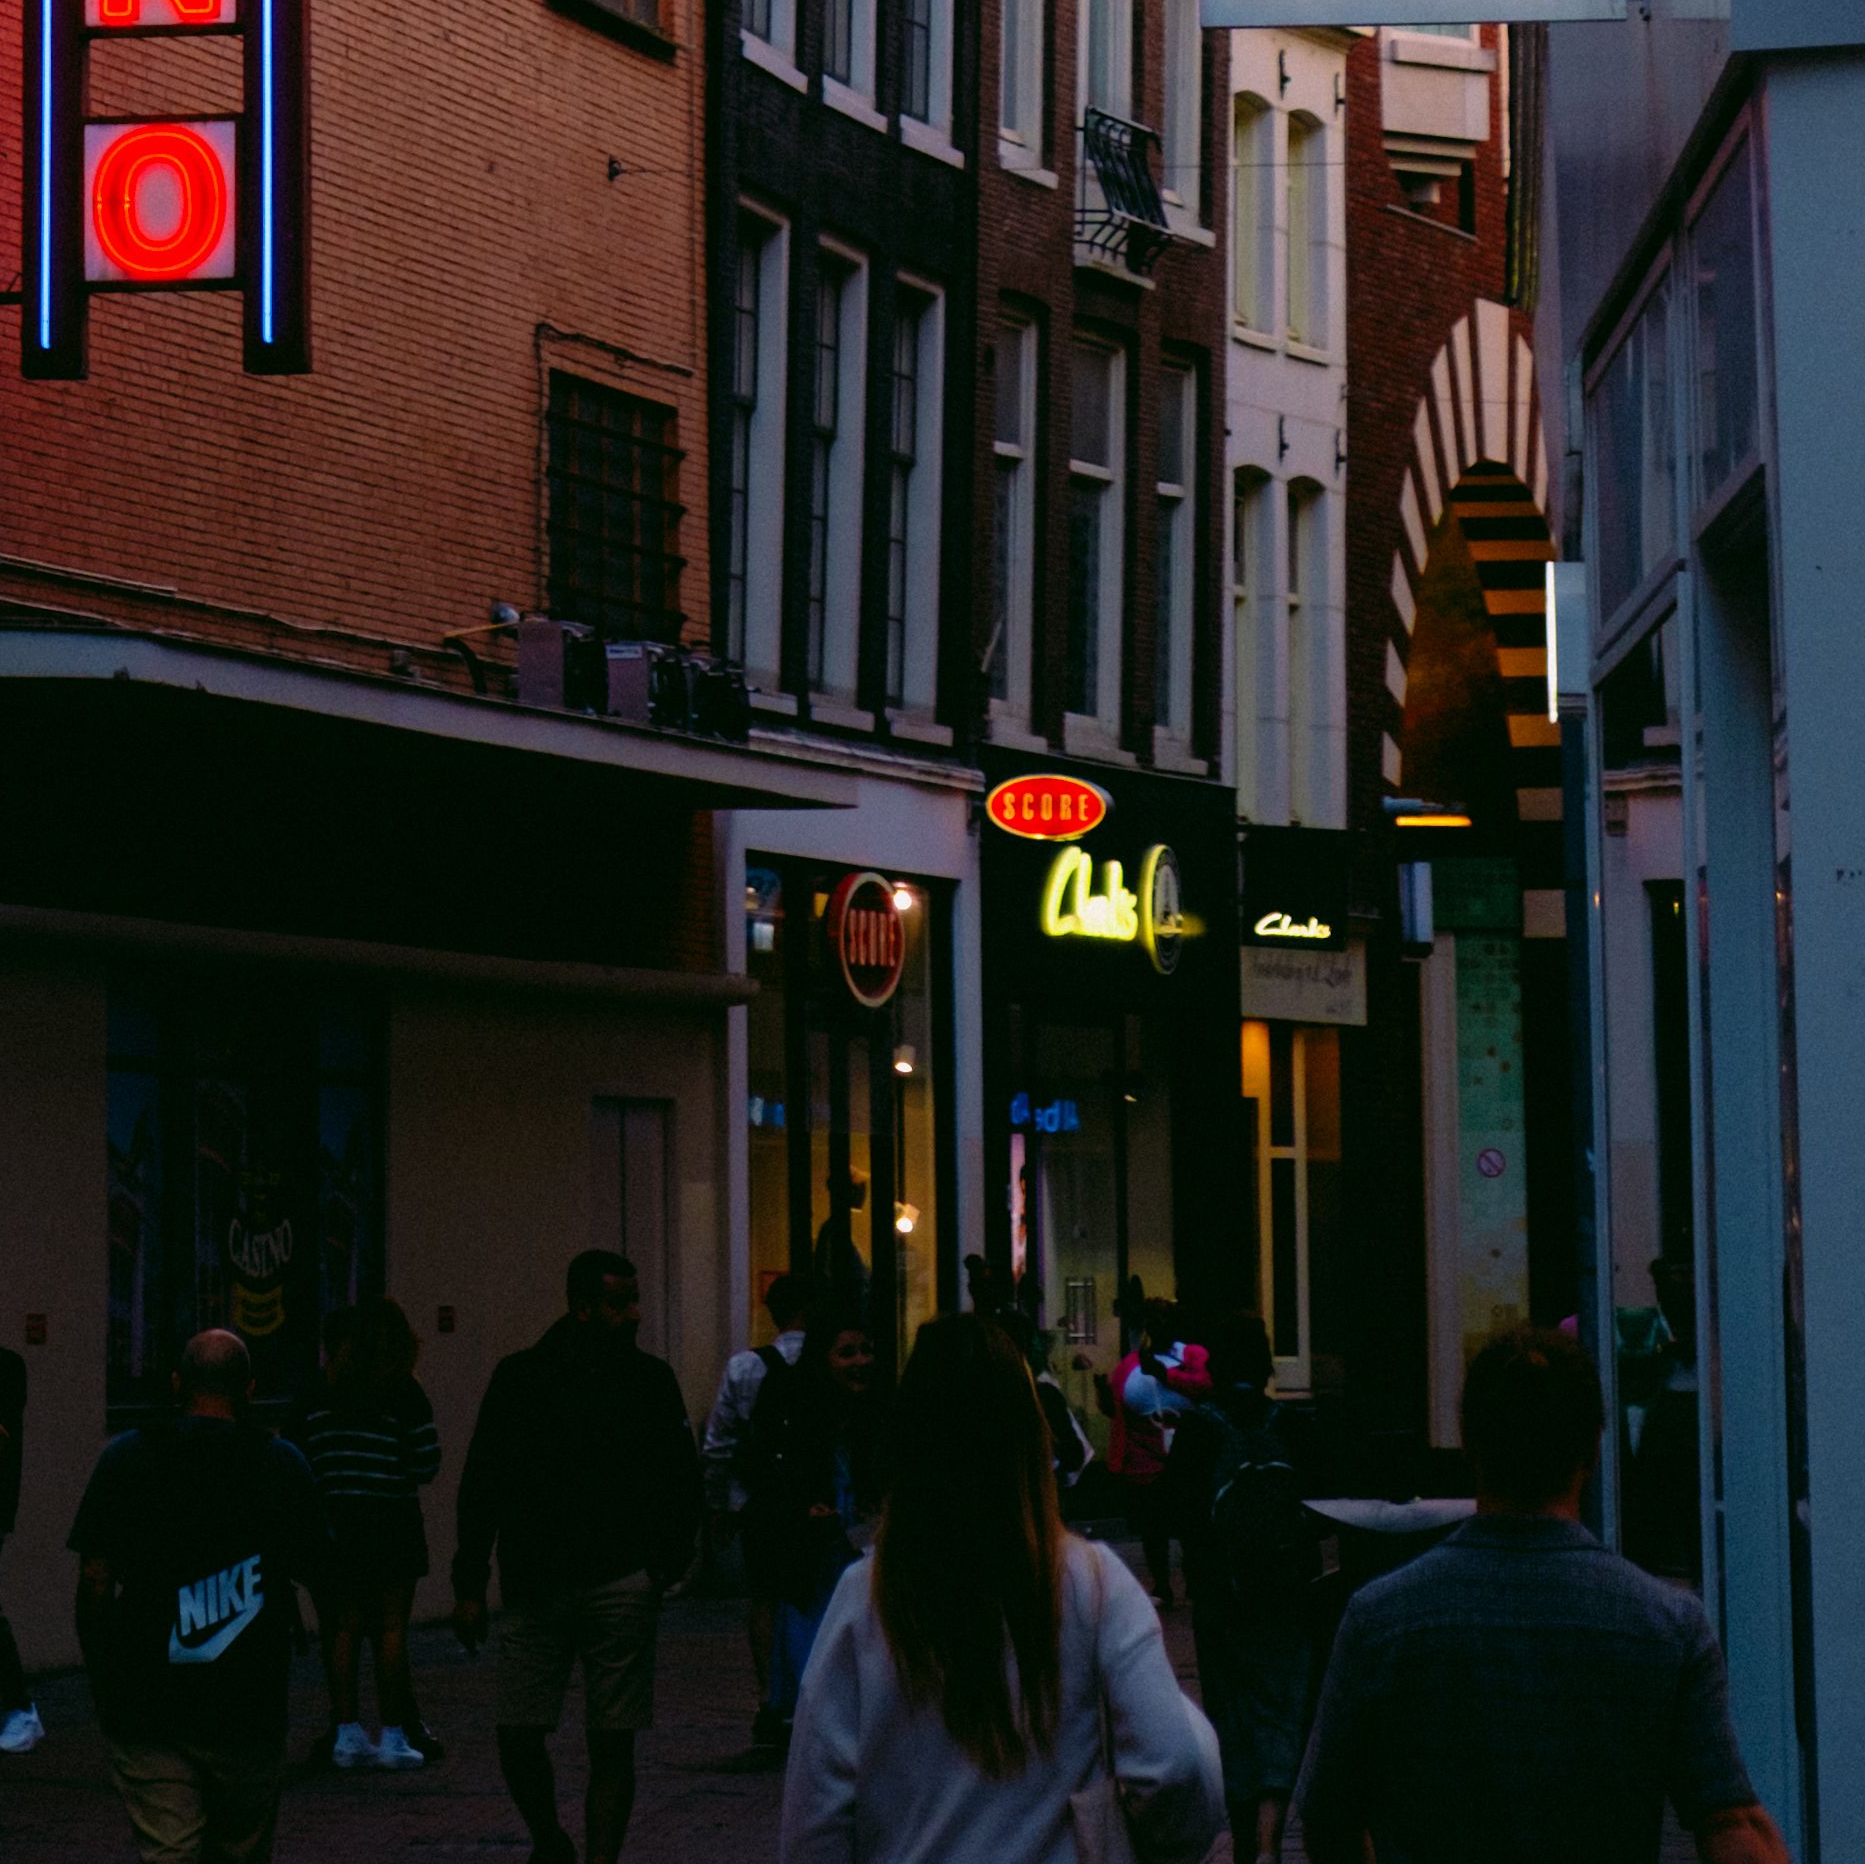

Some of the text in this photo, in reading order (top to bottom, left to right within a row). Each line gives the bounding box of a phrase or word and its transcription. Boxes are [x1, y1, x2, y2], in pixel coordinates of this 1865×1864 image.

[1002, 792, 1090, 822] SCORE
[848, 907, 897, 967] SCORE
[178, 1551, 266, 1638] NIKE
